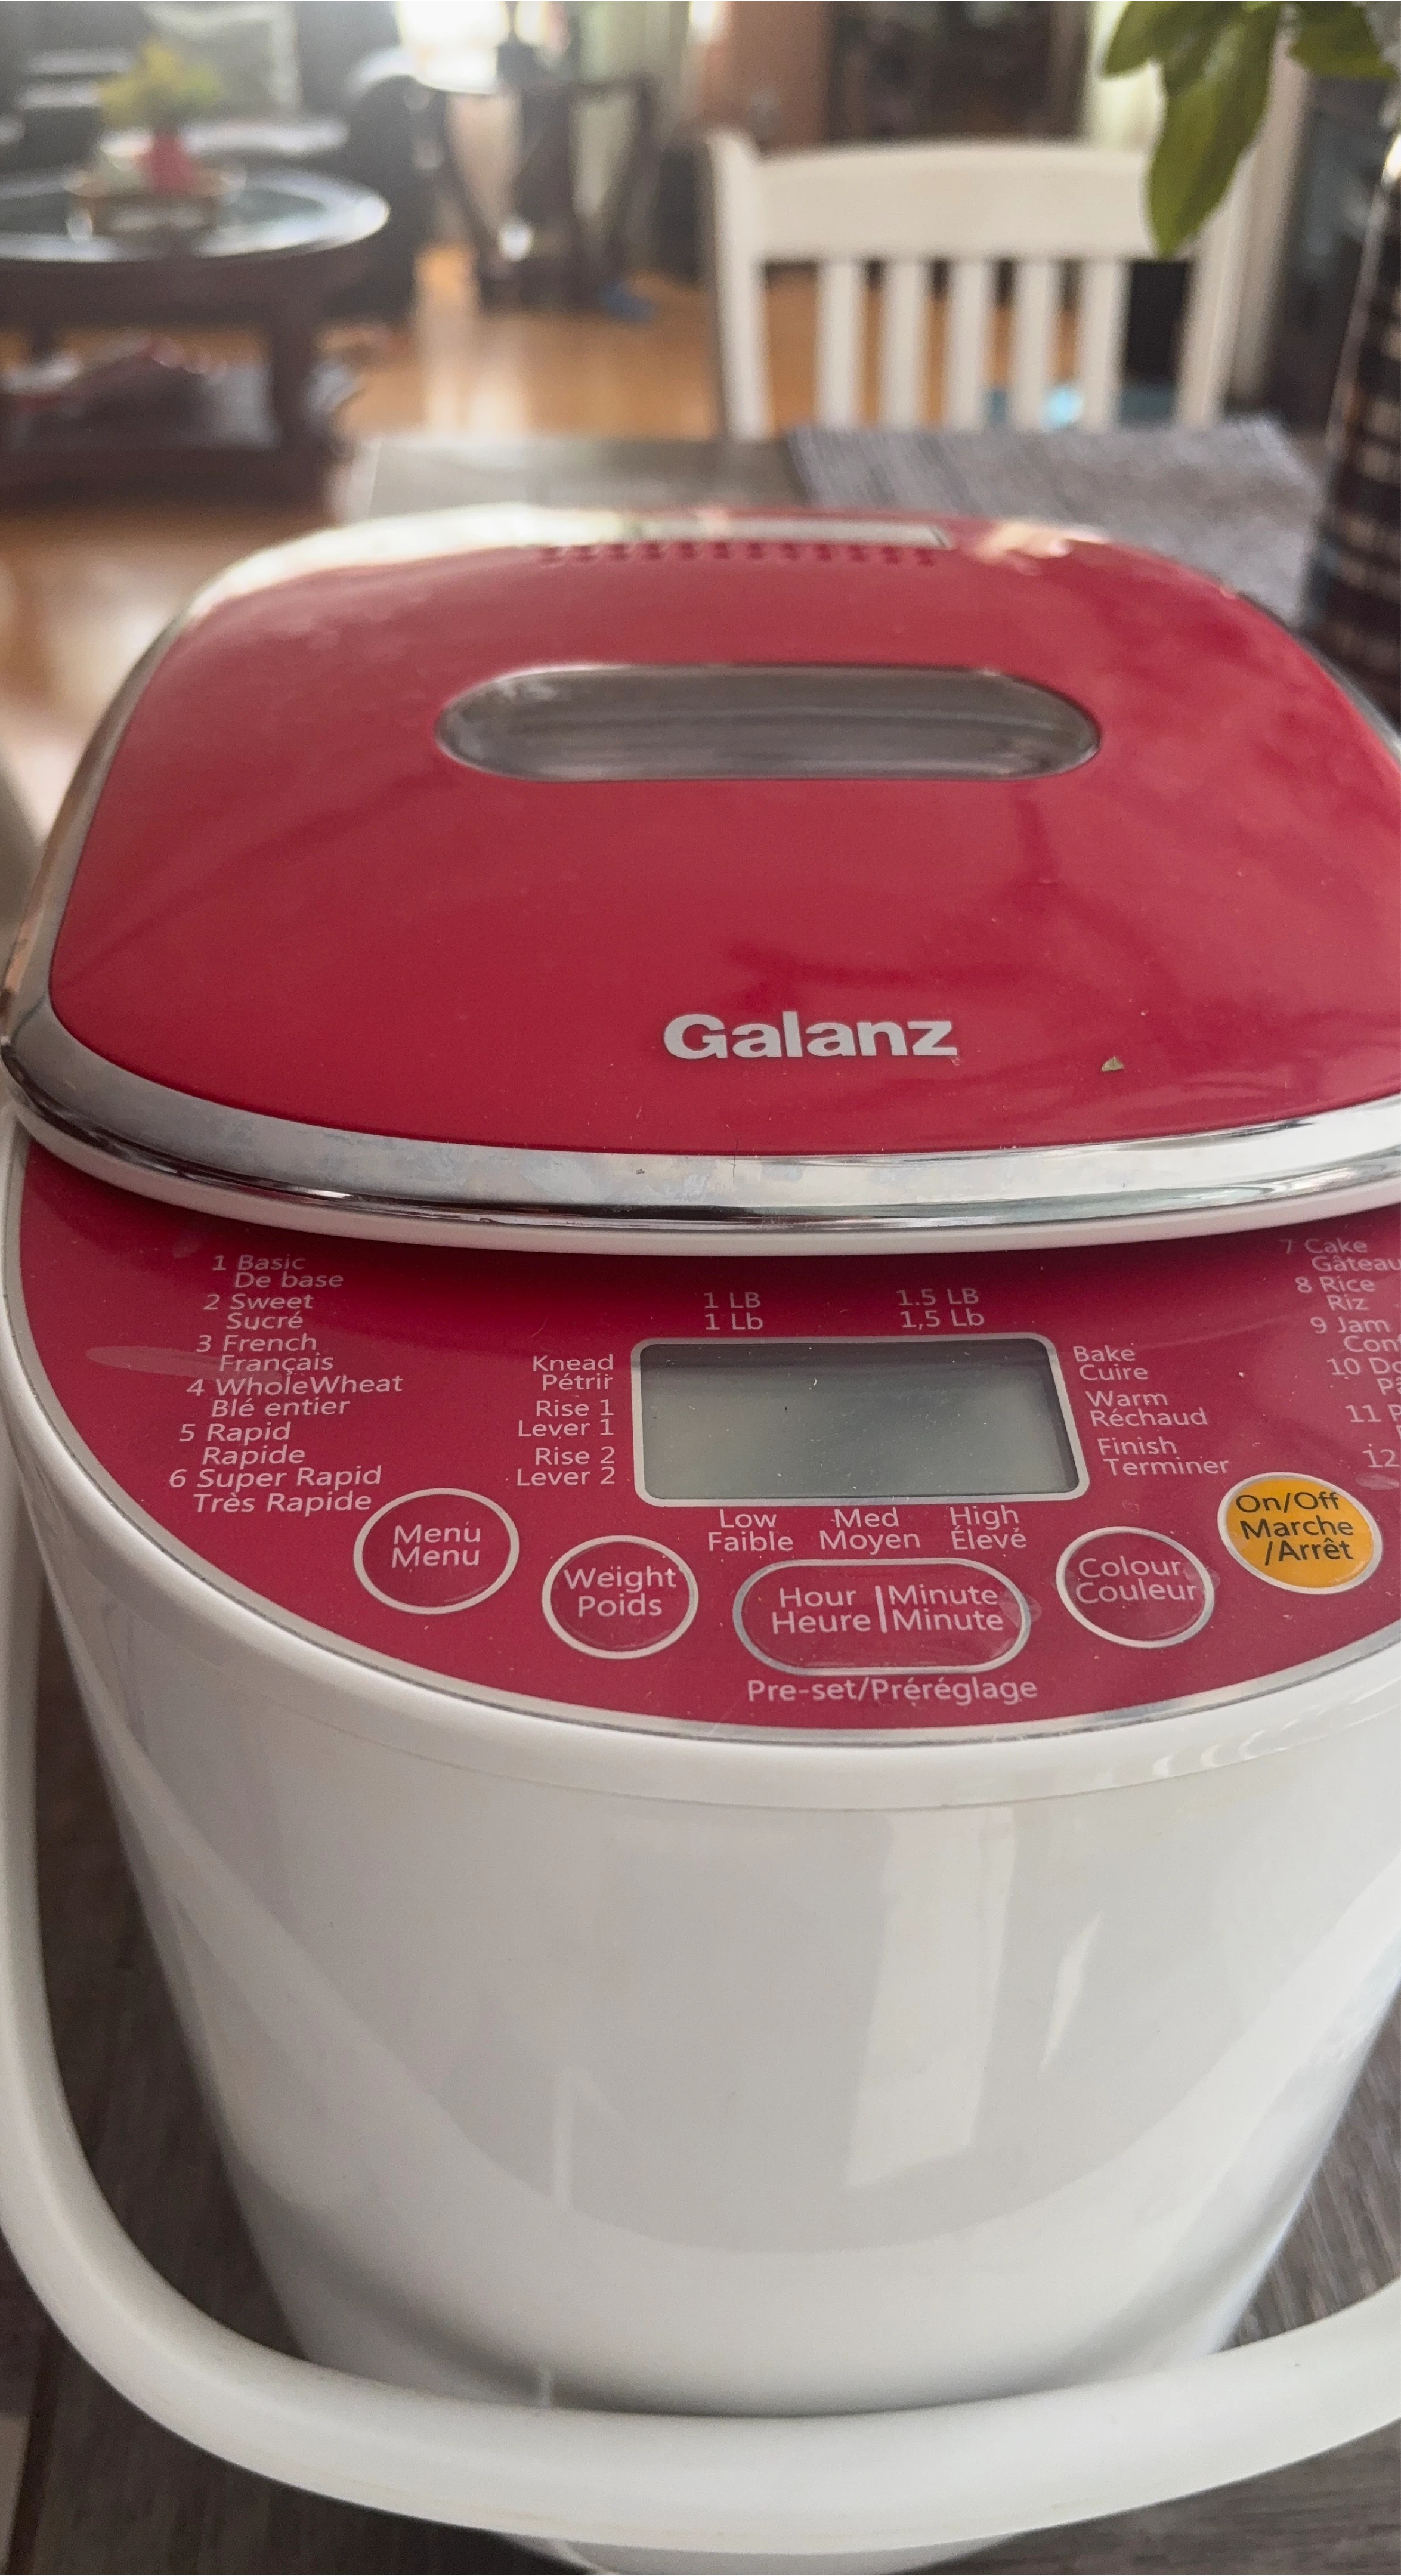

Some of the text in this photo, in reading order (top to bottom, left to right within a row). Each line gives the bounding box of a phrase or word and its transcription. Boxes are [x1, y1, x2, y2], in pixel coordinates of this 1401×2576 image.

[663, 1010, 958, 1060] Galanz
[1280, 1237, 1368, 1254] 7 Cake
[212, 1254, 305, 1271] 1 Basic
[1312, 1255, 1401, 1272] Gâteau
[234, 1272, 344, 1288] De base
[1295, 1275, 1375, 1293] 8 Rice
[203, 1294, 314, 1310] 2 Sweet
[704, 1292, 762, 1308] 1 LB
[896, 1288, 979, 1306] 1.5 LB
[1326, 1293, 1369, 1311] Riz
[226, 1312, 304, 1330] Sucré
[704, 1312, 764, 1330] 1 Lb
[900, 1308, 985, 1330] 1,5 Lb
[1310, 1316, 1390, 1334] 9 Jam
[196, 1333, 317, 1352] 3 French
[219, 1352, 334, 1375] Français
[533, 1354, 614, 1371] Knead
[1074, 1345, 1135, 1363] Bake
[1079, 1366, 1149, 1381] Cuire
[1326, 1358, 1360, 1375] 10
[186, 1375, 404, 1397] 4 WholeWheat
[542, 1373, 614, 1391] Pétrir
[211, 1399, 351, 1417] Blé entier
[536, 1399, 614, 1417] Rise 1
[1085, 1391, 1169, 1407] Warm
[1090, 1408, 1208, 1426] Réchaud
[1344, 1405, 1382, 1422] 11
[180, 1421, 292, 1446] 5 Rapid
[518, 1419, 614, 1437] Lever 1
[535, 1446, 615, 1465] Rise 2
[1097, 1437, 1178, 1456] Finish
[202, 1444, 306, 1469] Rapide
[1362, 1449, 1400, 1467] 12
[1103, 1457, 1229, 1476] Terminer
[169, 1465, 382, 1493] 6 Super Rapid
[517, 1467, 615, 1486] Lever 2
[193, 1491, 372, 1516] Très Rapide
[1236, 1491, 1341, 1515] On/Off
[719, 1509, 777, 1528] Low
[834, 1507, 898, 1528] Med
[950, 1505, 1019, 1530] High
[394, 1524, 481, 1544] Menu
[1240, 1515, 1354, 1540] Marche
[708, 1531, 794, 1552] Faible
[820, 1530, 921, 1555] Moyen
[951, 1527, 1027, 1550] Élevé
[391, 1546, 480, 1568] Menu
[1264, 1537, 1354, 1566] /Arrêt
[1078, 1555, 1182, 1578] Colour
[563, 1565, 677, 1594] Weight
[779, 1584, 998, 1608] Hour Minute
[1075, 1580, 1198, 1605] Couleur
[577, 1593, 663, 1618] Poids
[772, 1609, 1004, 1634] Heure Minute
[748, 1676, 1038, 1706] Pre-set/Préréglage
